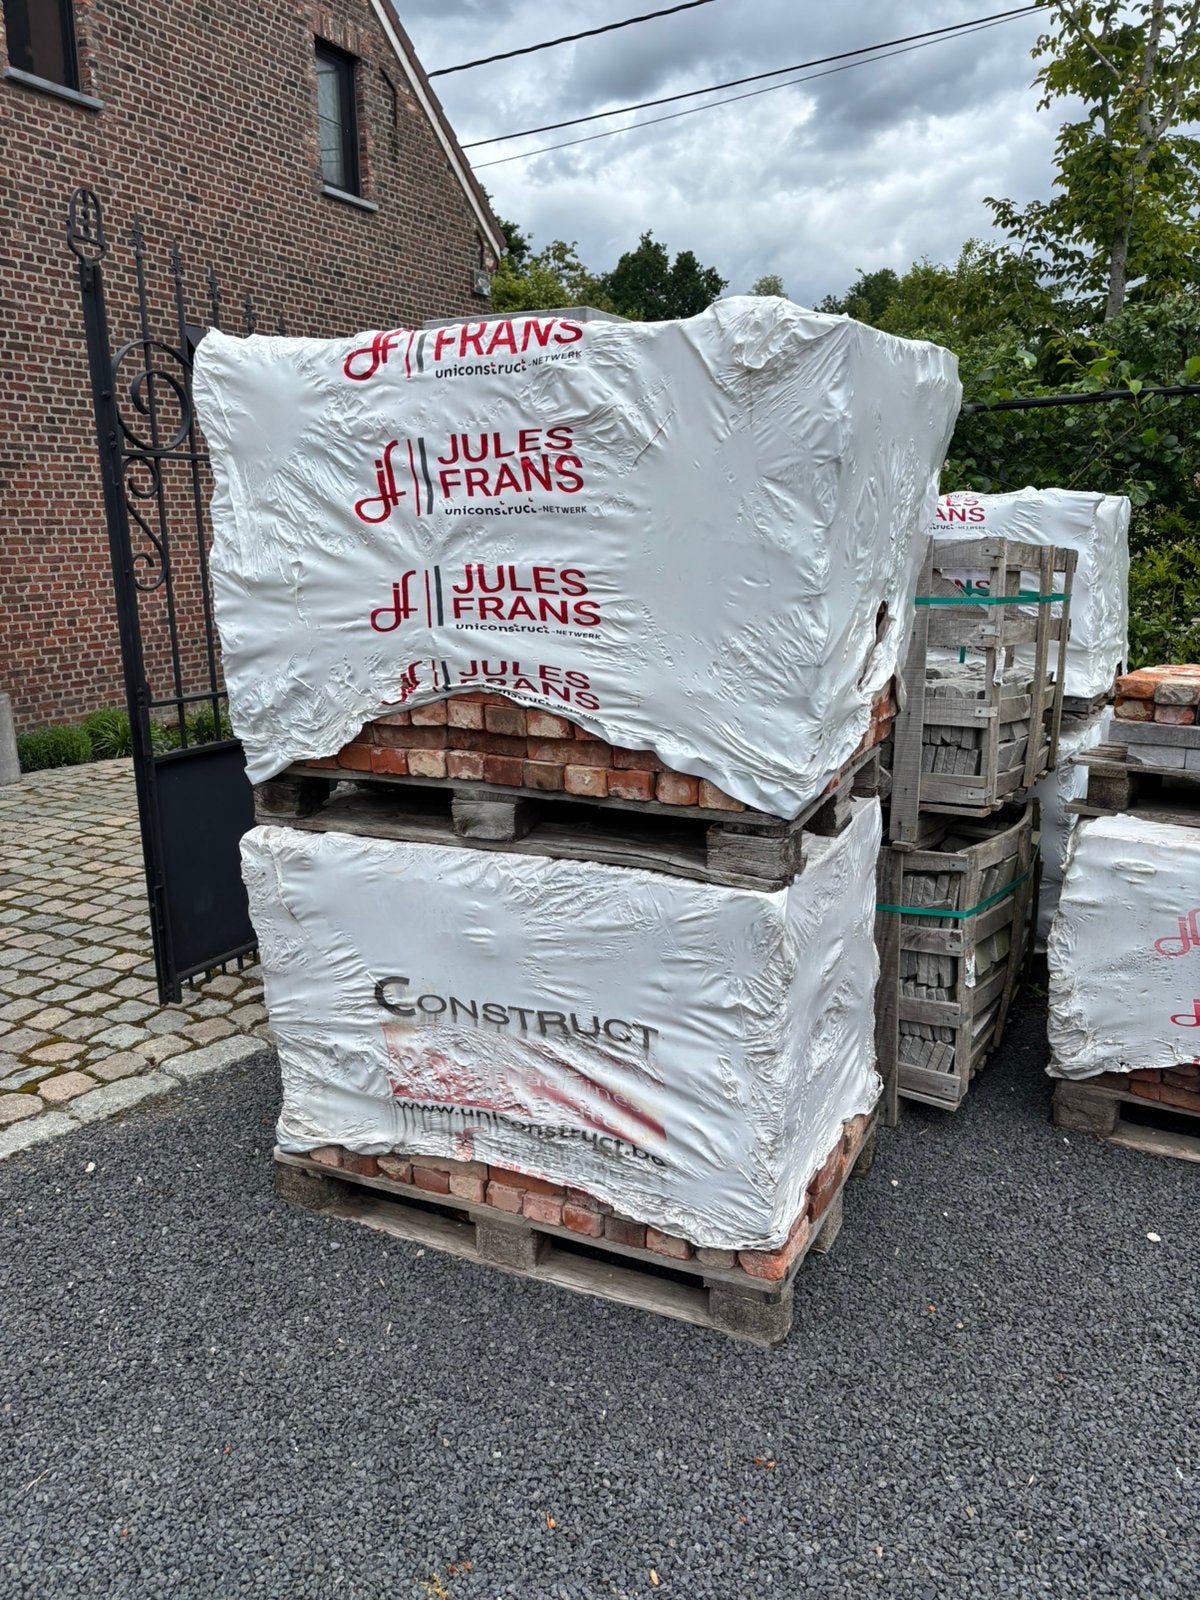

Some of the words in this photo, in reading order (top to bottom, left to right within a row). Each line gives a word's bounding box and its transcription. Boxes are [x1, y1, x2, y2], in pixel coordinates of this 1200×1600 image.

[434, 317, 583, 361] FRANS
[437, 426, 573, 464] JULES
[438, 454, 584, 498] FRANS
[936, 507, 986, 522] ANS
[452, 563, 589, 597] JULES
[452, 596, 601, 627] FRANS
[458, 660, 591, 690] JULES
